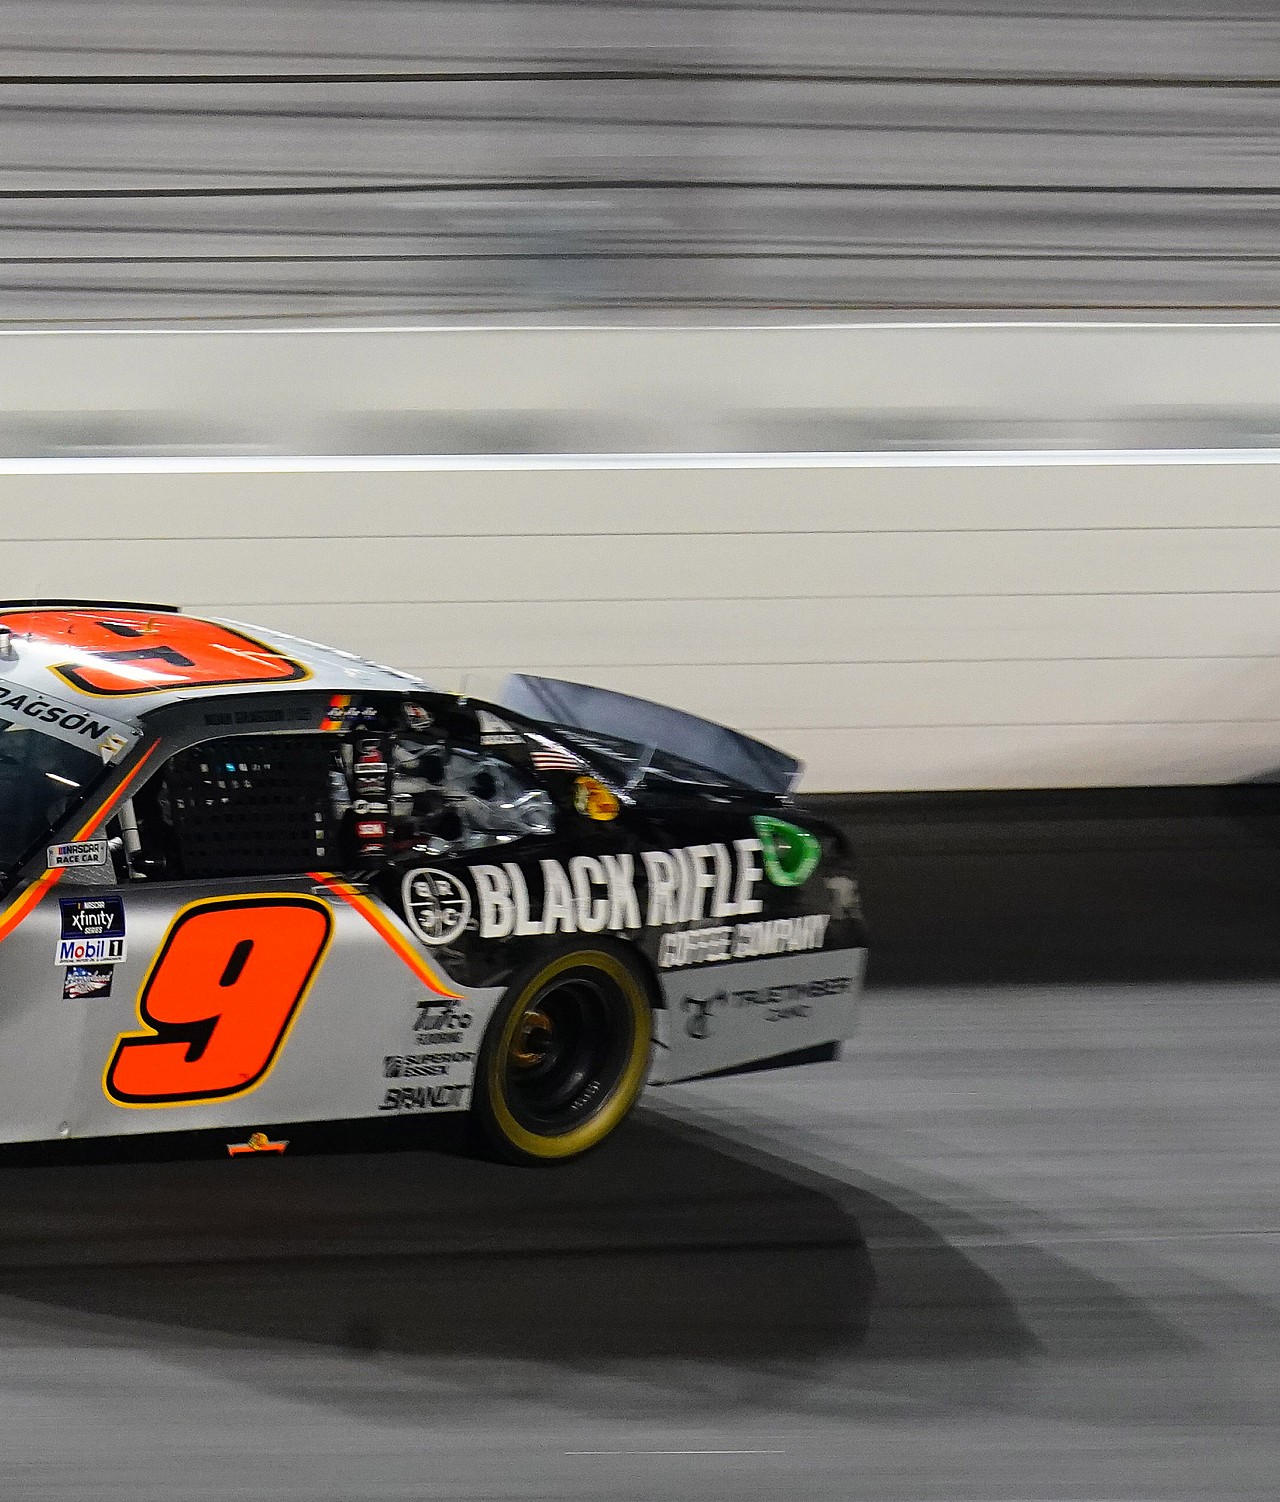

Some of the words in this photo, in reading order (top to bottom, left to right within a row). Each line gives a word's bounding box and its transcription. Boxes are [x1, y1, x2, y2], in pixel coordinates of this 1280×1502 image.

[56, 854, 80, 864] RACE
[82, 853, 99, 863] CAR
[66, 843, 100, 855] NASCAR
[467, 853, 642, 939] BLACK
[639, 838, 764, 927] RIFLE
[72, 910, 115, 931] xfinity
[60, 940, 105, 960] Mobil
[111, 940, 121, 956] 1
[103, 892, 336, 1109] 9
